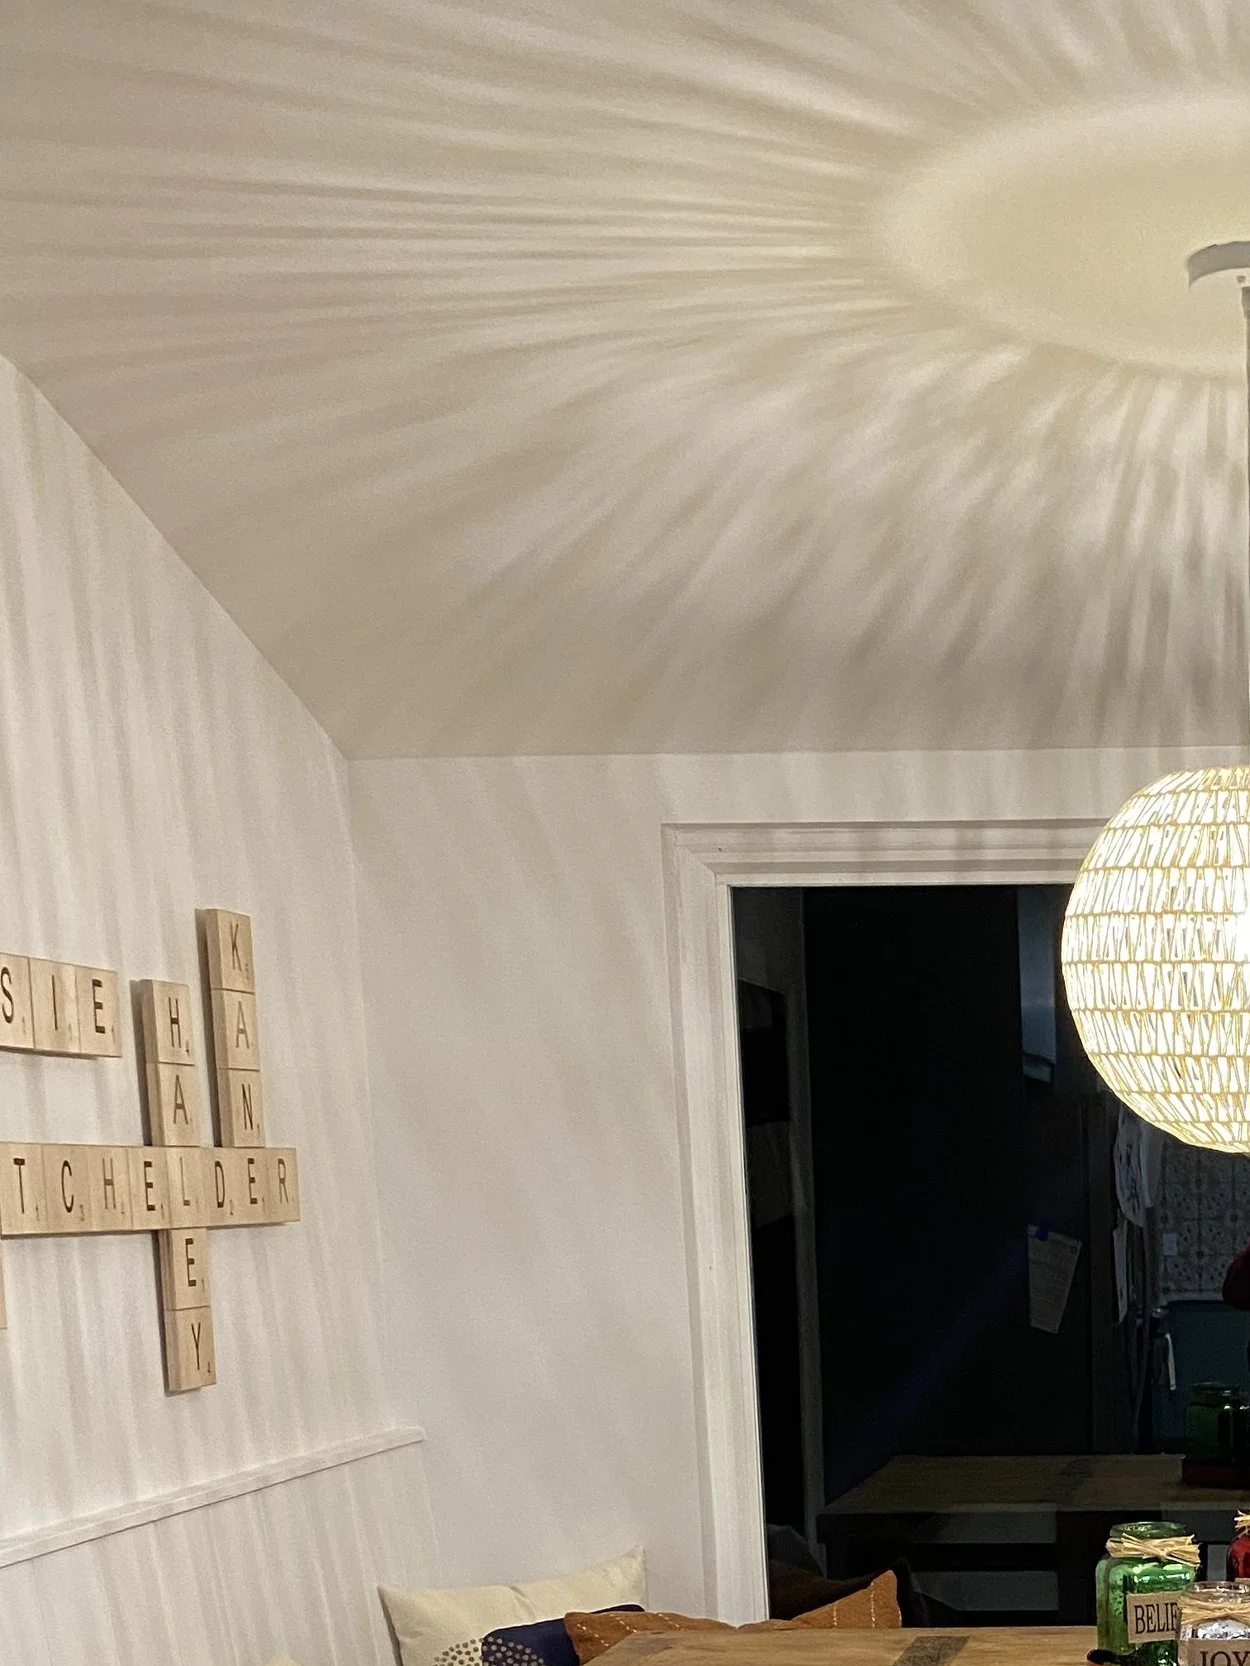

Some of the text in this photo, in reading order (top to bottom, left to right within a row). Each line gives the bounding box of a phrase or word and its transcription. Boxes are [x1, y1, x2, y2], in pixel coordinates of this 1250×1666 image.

[0, 966, 106, 1035] SIE
[13, 1157, 289, 1214] TCHELDER
[1134, 1602, 1180, 1635] BELIE
